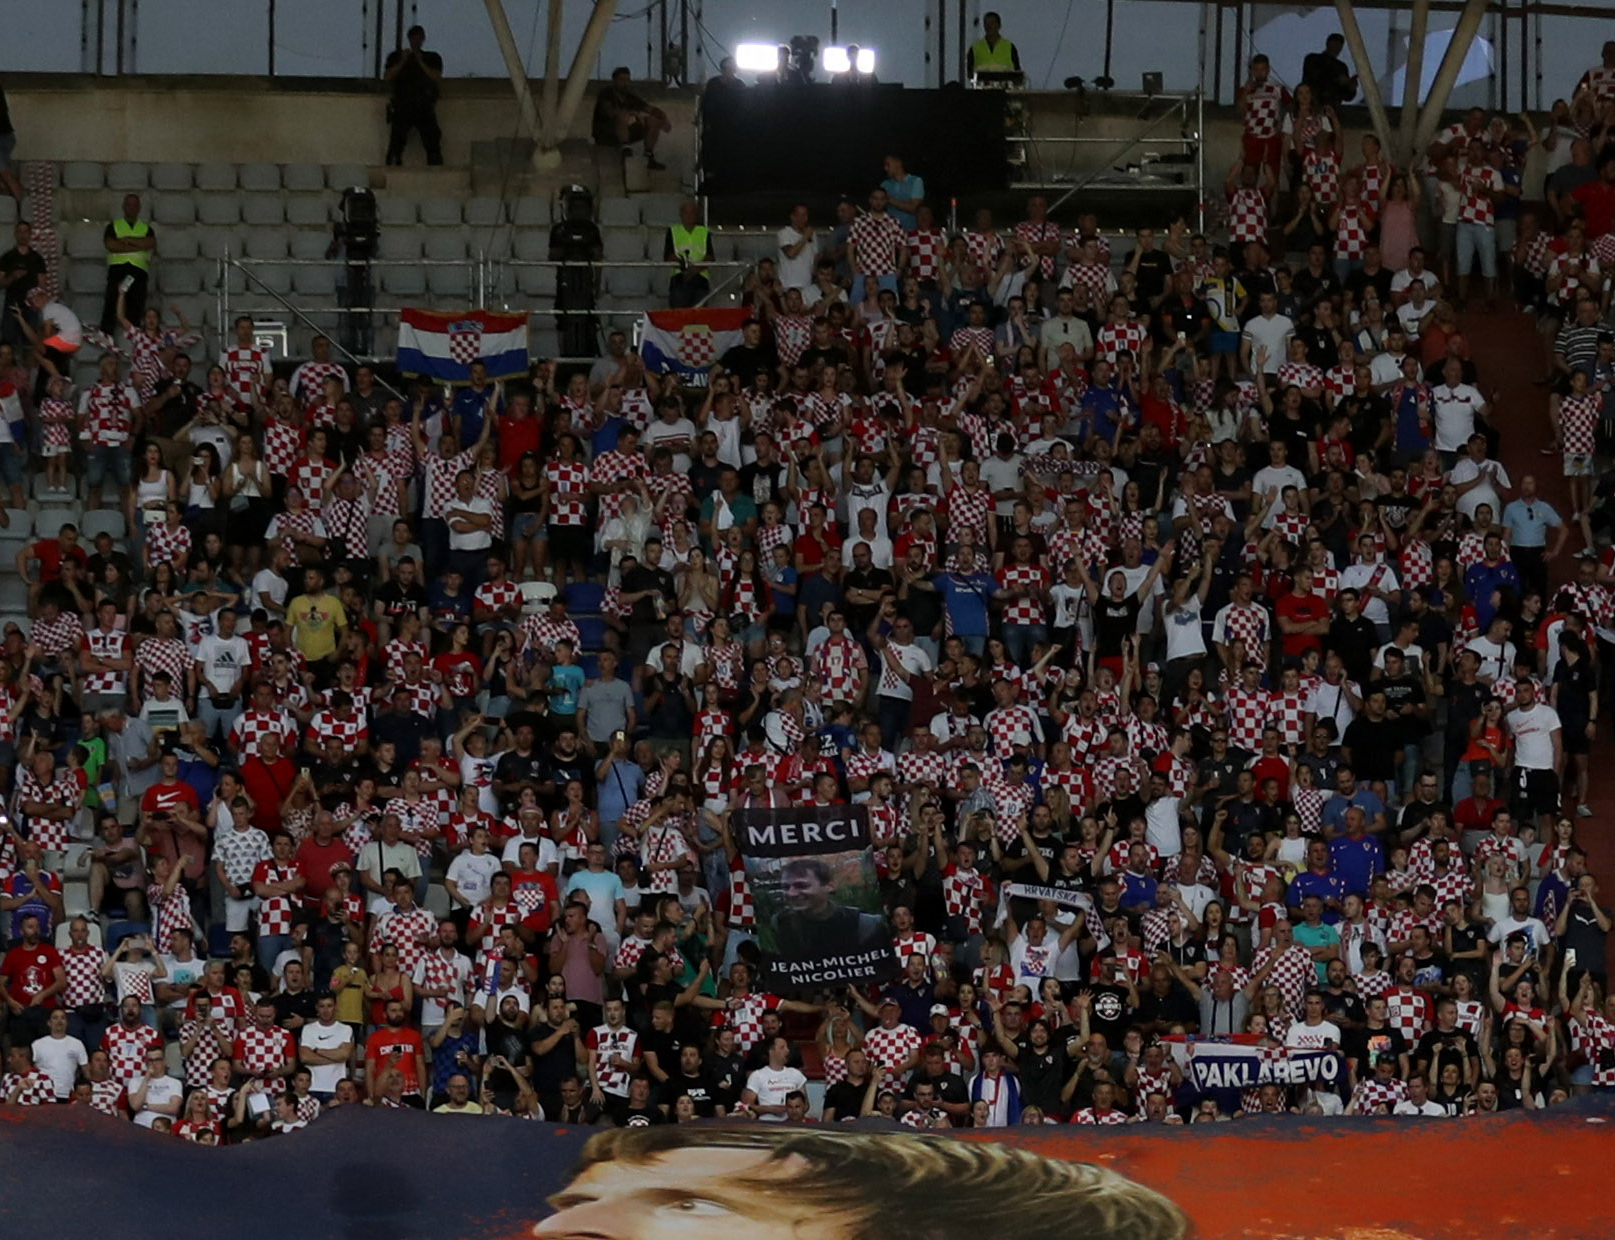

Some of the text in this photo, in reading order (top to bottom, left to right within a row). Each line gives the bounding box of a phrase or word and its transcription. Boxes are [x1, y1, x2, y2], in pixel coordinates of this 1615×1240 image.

[748, 819, 860, 847] MERCI
[1024, 885, 1077, 903] HRVATSKA
[770, 948, 890, 974] JEAN-MICHEL
[791, 965, 877, 985] NICOLIER
